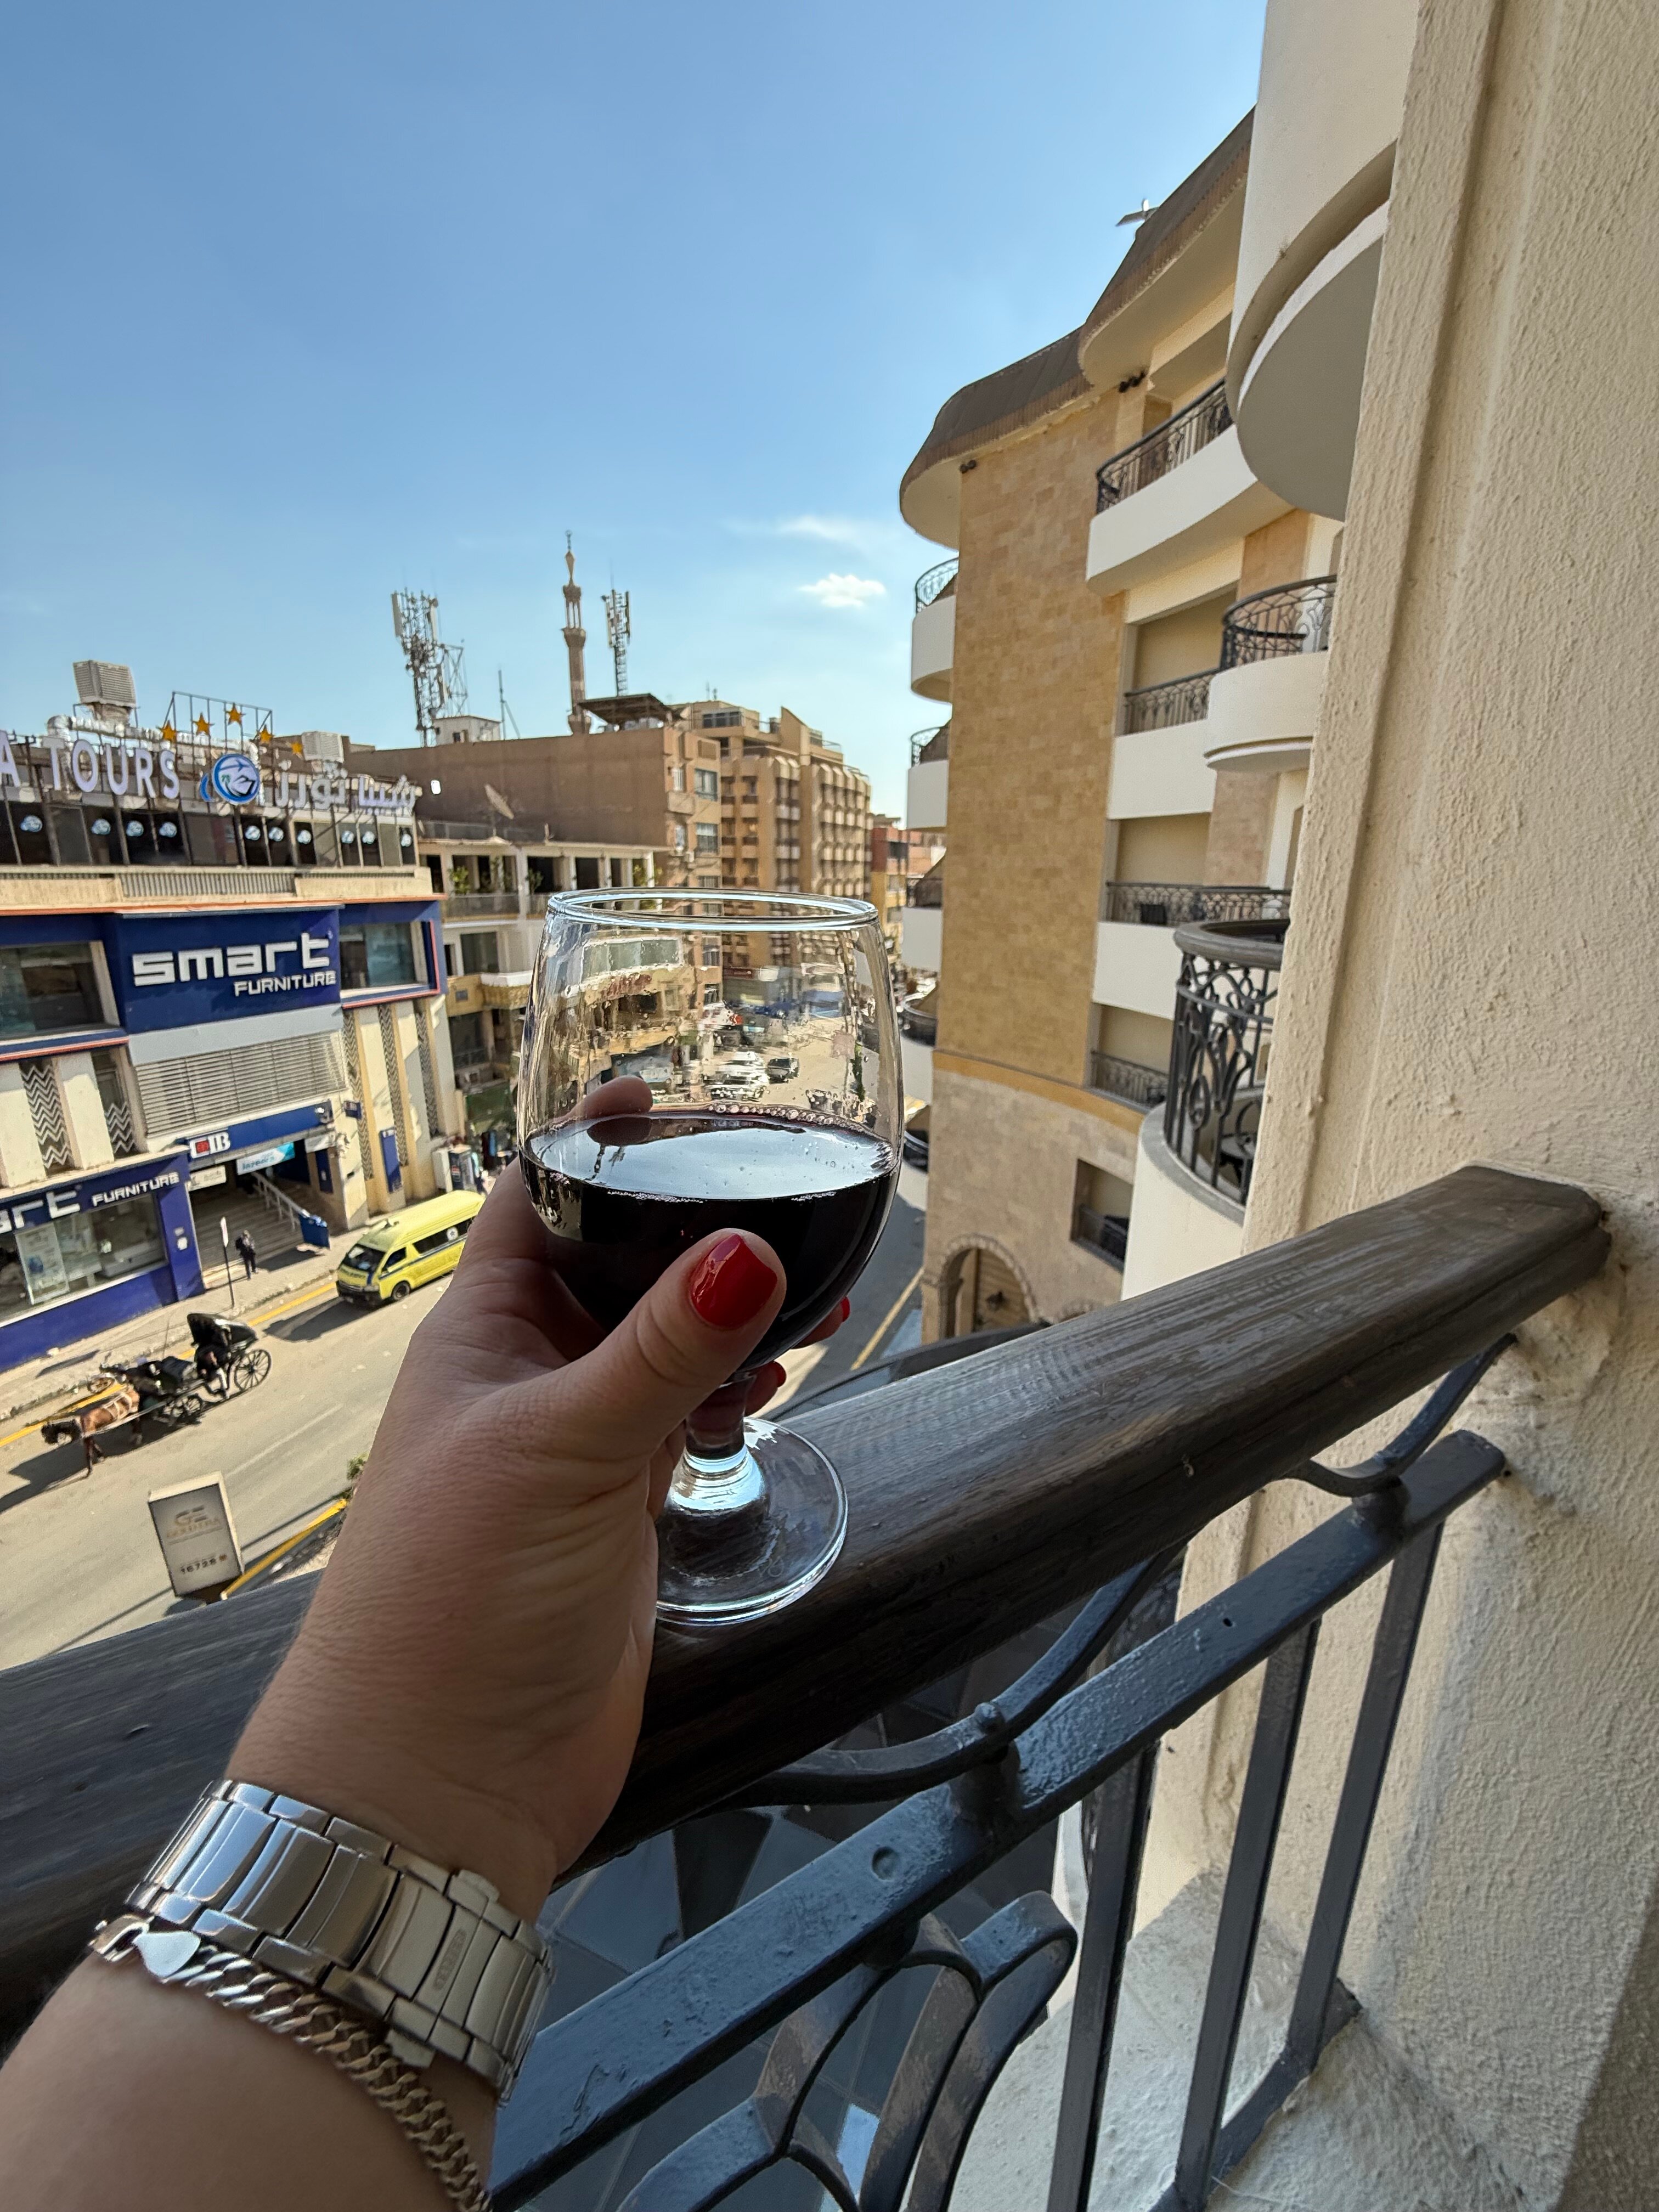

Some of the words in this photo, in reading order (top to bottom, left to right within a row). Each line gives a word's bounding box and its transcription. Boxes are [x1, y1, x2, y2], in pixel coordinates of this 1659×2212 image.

[41, 736, 180, 799] TOURS
[275, 759, 348, 810] تورز
[132, 933, 330, 986] smart
[234, 970, 336, 997] FURNITURE
[189, 1132, 230, 1159] CIB
[92, 1172, 180, 1206] FURNITURE
